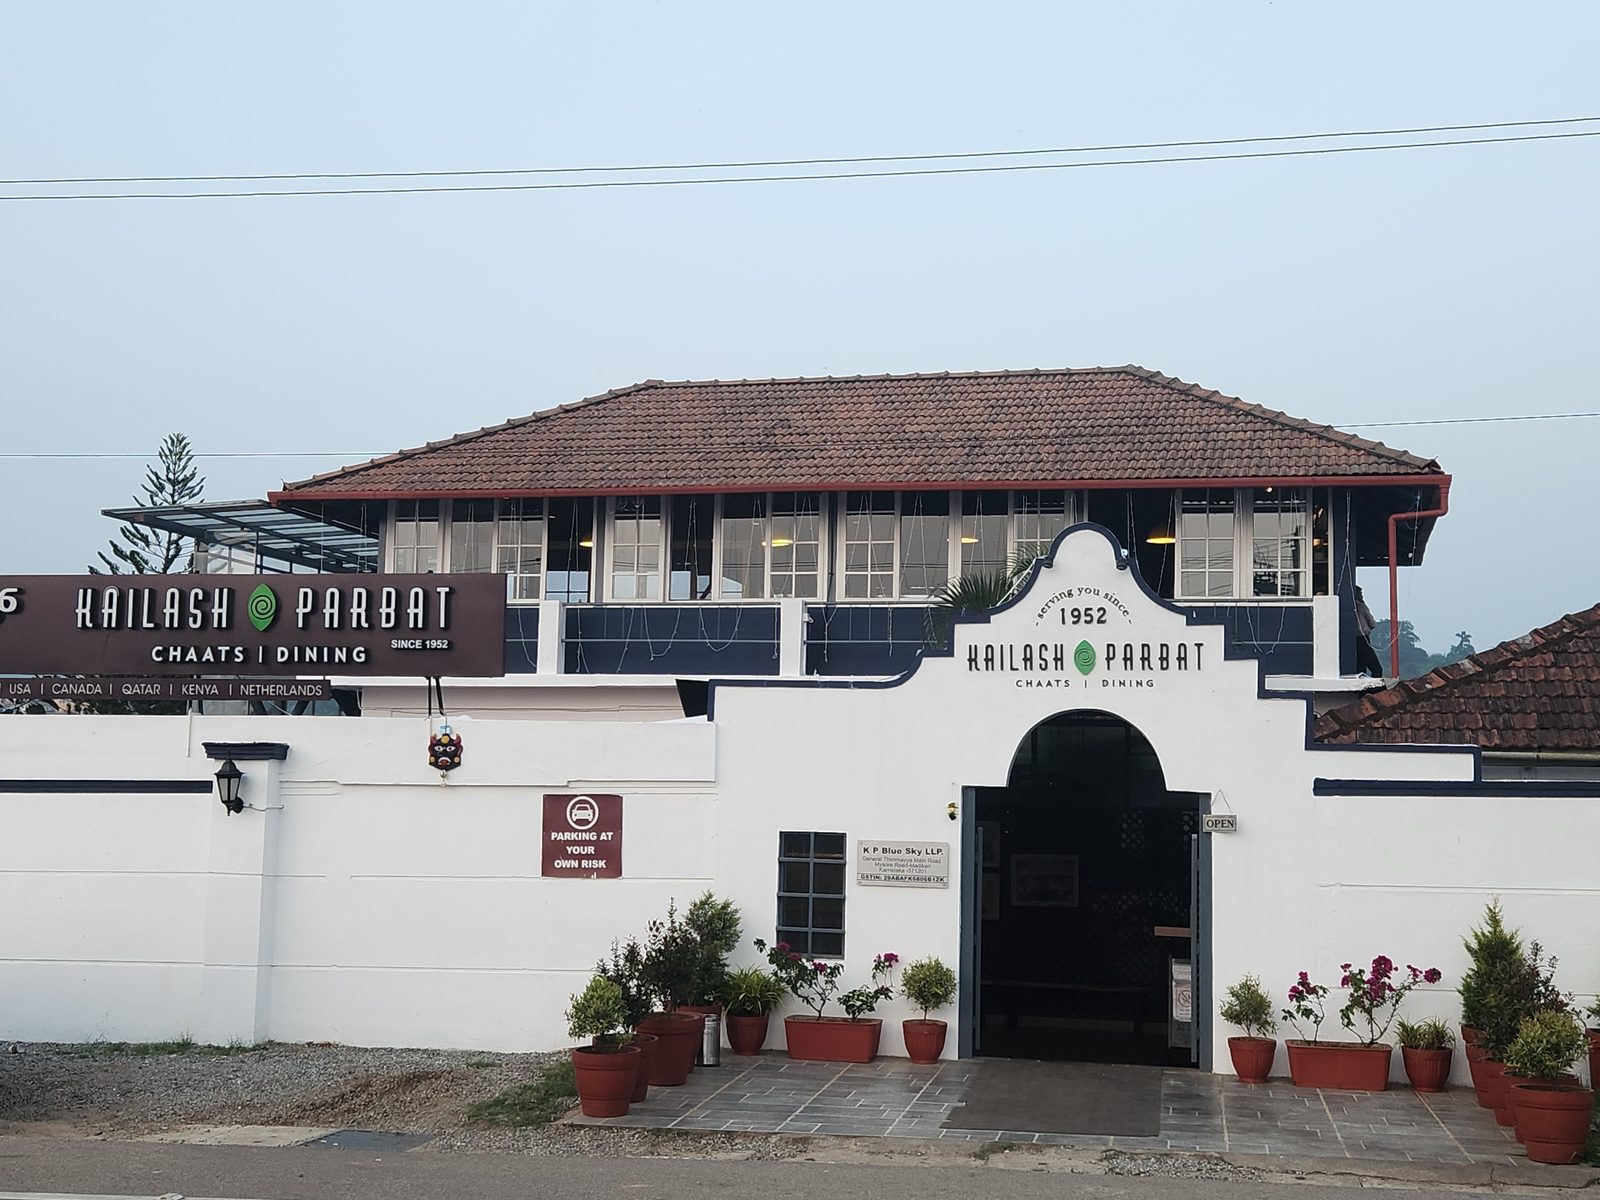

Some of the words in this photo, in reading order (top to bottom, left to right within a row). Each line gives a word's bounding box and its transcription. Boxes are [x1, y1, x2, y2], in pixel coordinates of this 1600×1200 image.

[75, 587, 229, 628] KAILASH
[295, 587, 450, 629] PARBAT
[1037, 588, 1074, 619] serving
[1077, 587, 1100, 597] you
[1103, 592, 1130, 617] since
[1060, 607, 1107, 625] 1952
[391, 639, 422, 649] SINCE
[425, 639, 449, 649] 1952
[151, 645, 245, 663] CHAATS
[277, 645, 367, 663] DINING
[967, 643, 1064, 672] KAILASH
[1105, 642, 1204, 671] PARBAT
[1015, 679, 1071, 688] CHAATS
[1102, 679, 1155, 688] DINING
[9, 683, 32, 695] USA
[51, 683, 103, 695] CANADA
[121, 683, 161, 696] QATAR
[181, 684, 219, 696] KENYA
[240, 684, 323, 696] NETHERLANDS
[1206, 819, 1234, 828] OPEN
[551, 831, 597, 841] PARKING
[599, 831, 615, 841] AT
[566, 845, 595, 855] YOUR
[882, 847, 903, 855] Blue
[905, 848, 922, 856] Sky
[554, 859, 579, 869] OWN
[581, 859, 607, 869] RISK
